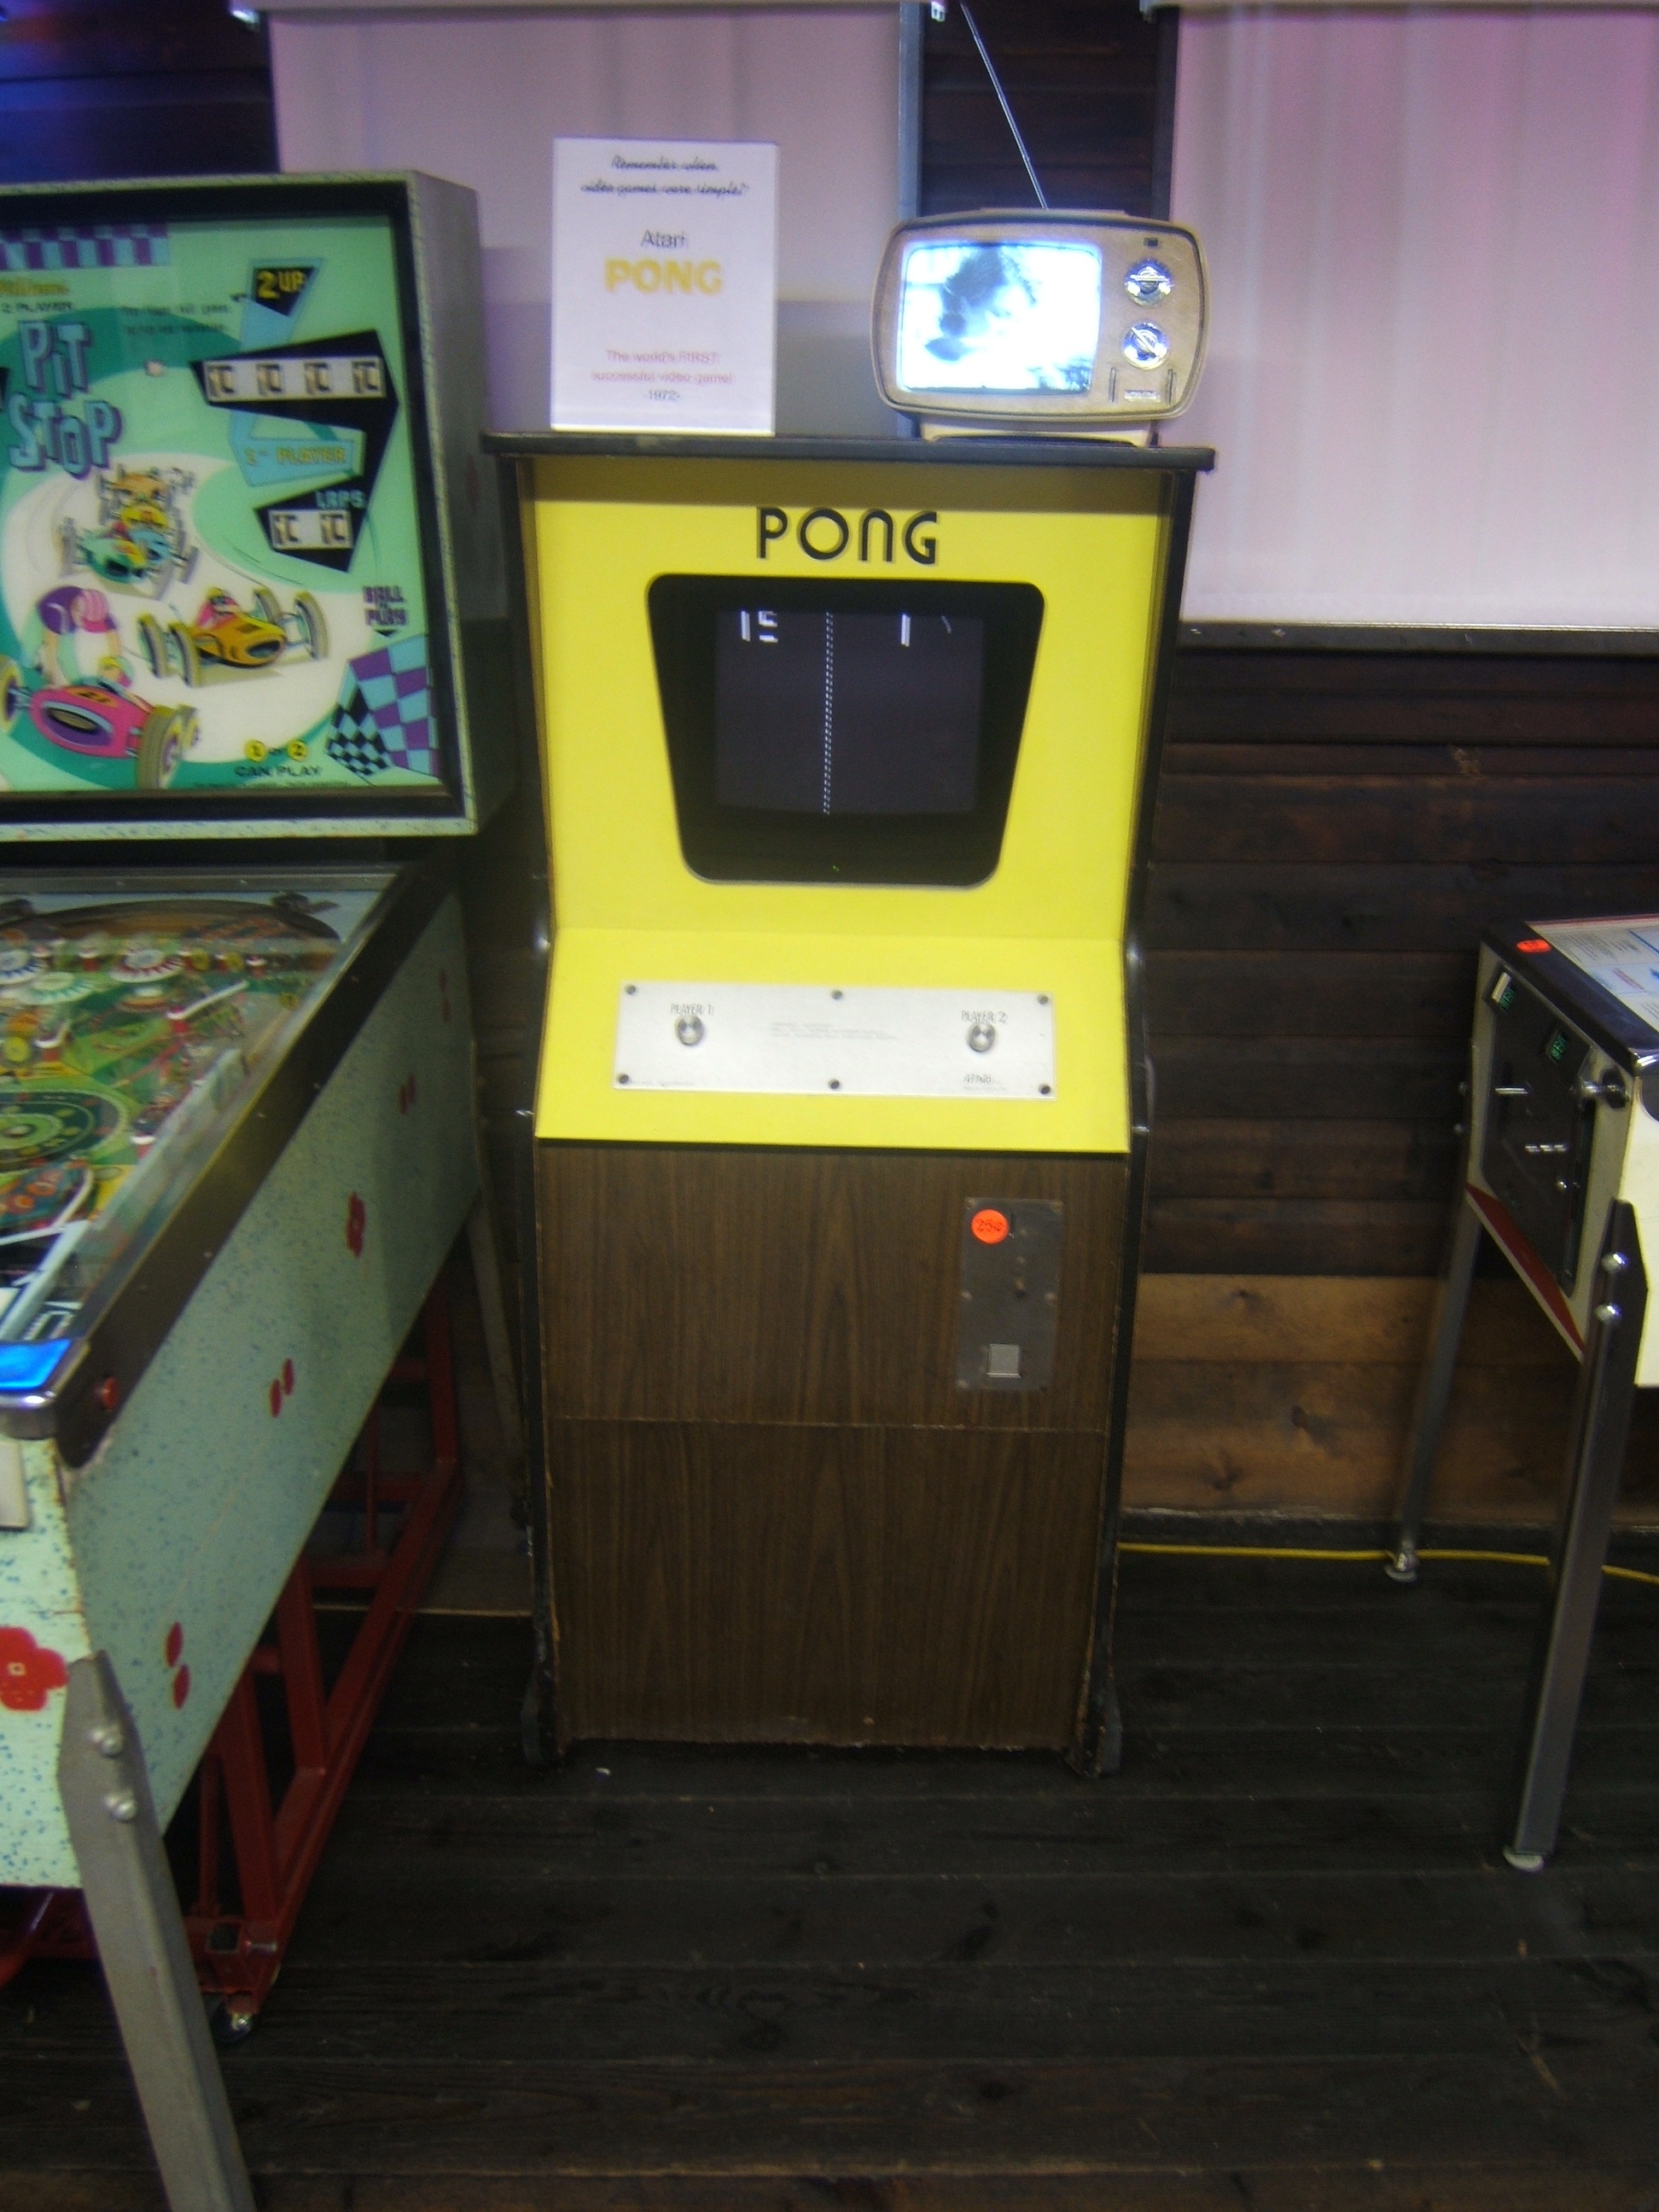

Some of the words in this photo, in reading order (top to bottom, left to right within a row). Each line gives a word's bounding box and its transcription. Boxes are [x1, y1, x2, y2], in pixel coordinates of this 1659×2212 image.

[641, 230, 689, 250] Atari
[604, 259, 722, 296] PONG
[607, 350, 630, 363] The
[678, 351, 719, 365] FIRST
[659, 371, 690, 383] video
[756, 507, 938, 565] PONG
[276, 765, 323, 777] PLAY
